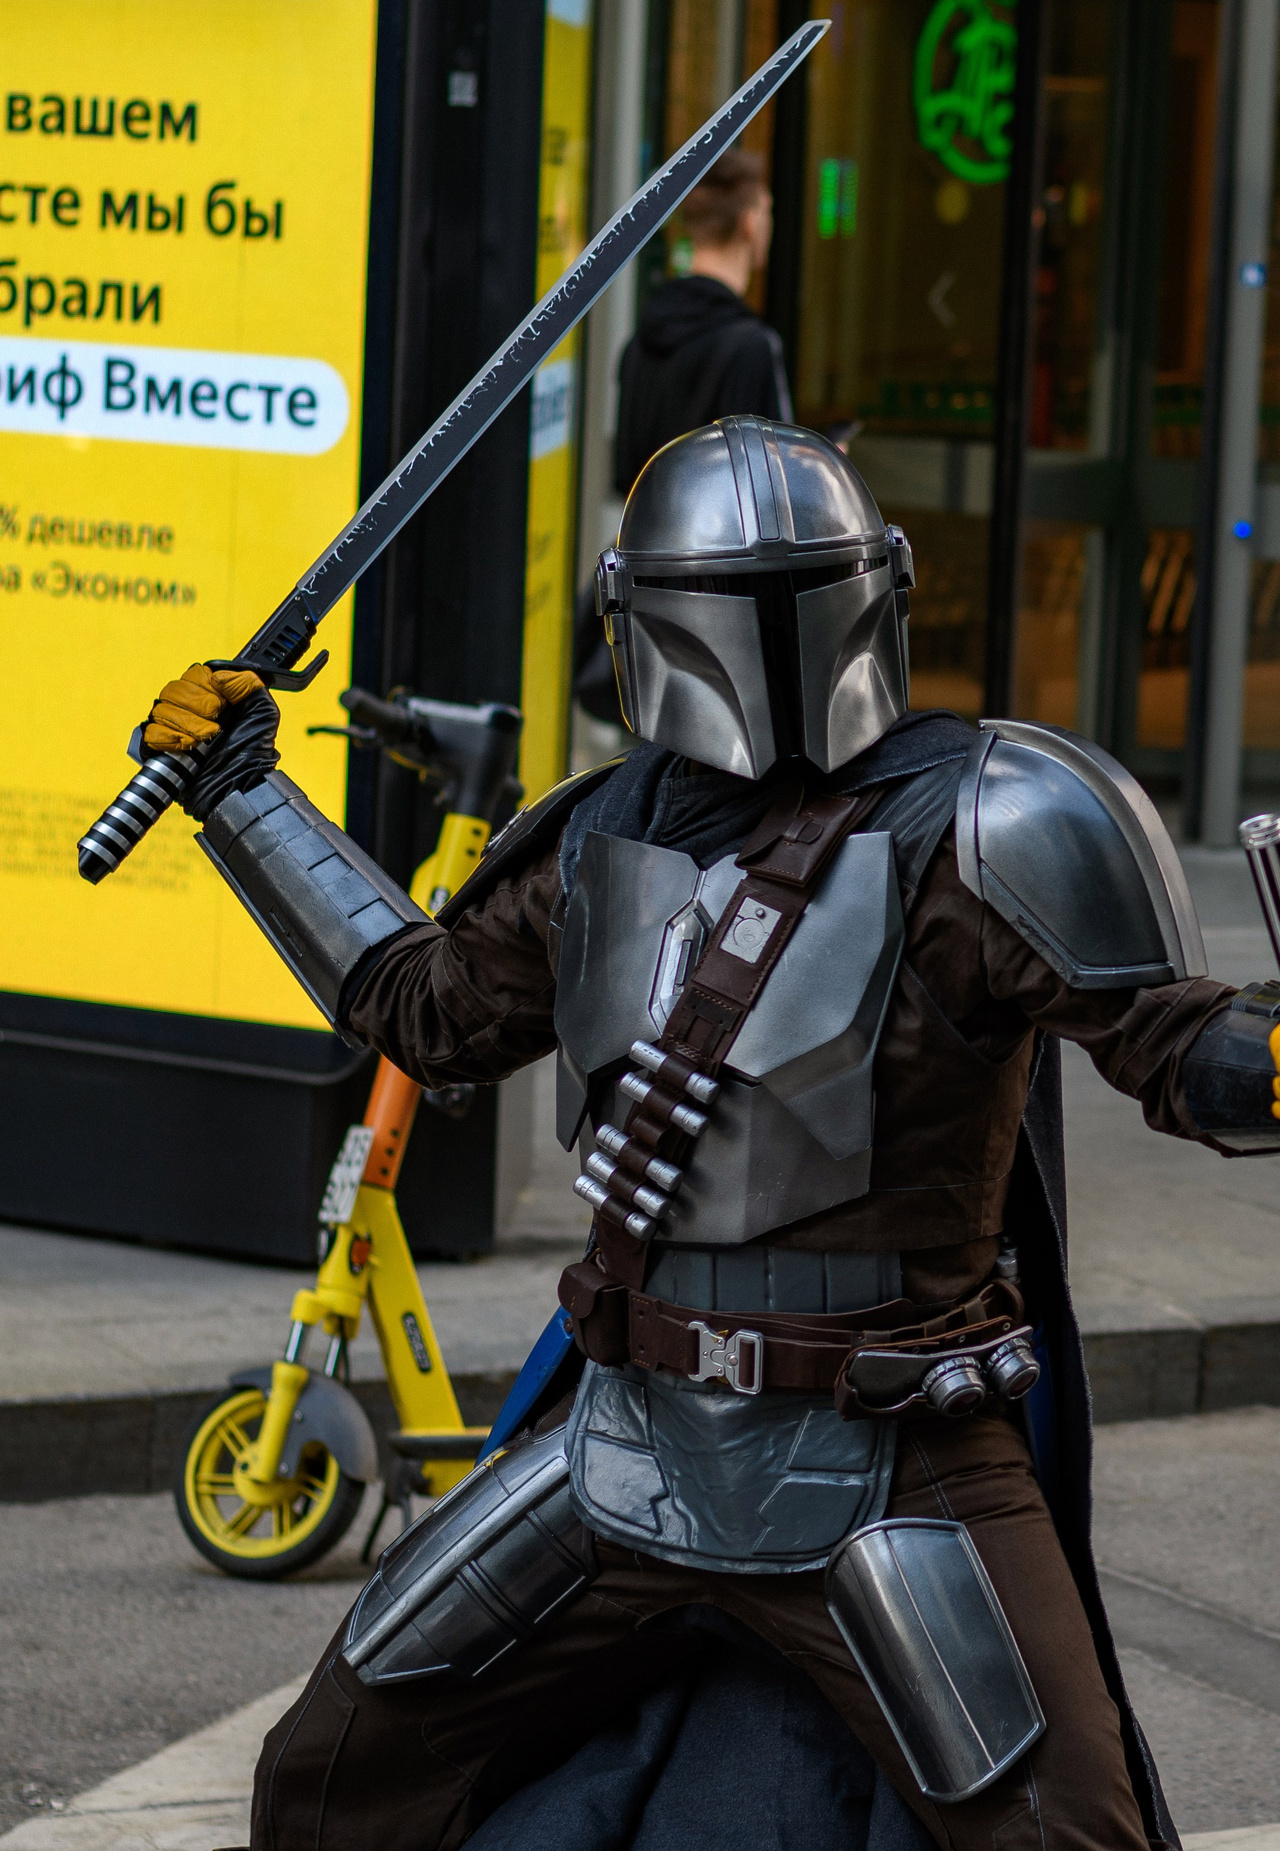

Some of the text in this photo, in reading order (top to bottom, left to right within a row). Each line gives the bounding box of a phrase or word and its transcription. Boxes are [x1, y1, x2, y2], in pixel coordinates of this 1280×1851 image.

[6, 93, 198, 142] вашем
[100, 189, 185, 234] мы
[205, 180, 283, 240] бы
[0, 352, 318, 427] иф Вместе
[26, 513, 175, 555] дешевле
[31, 560, 197, 607] «Эконом»
